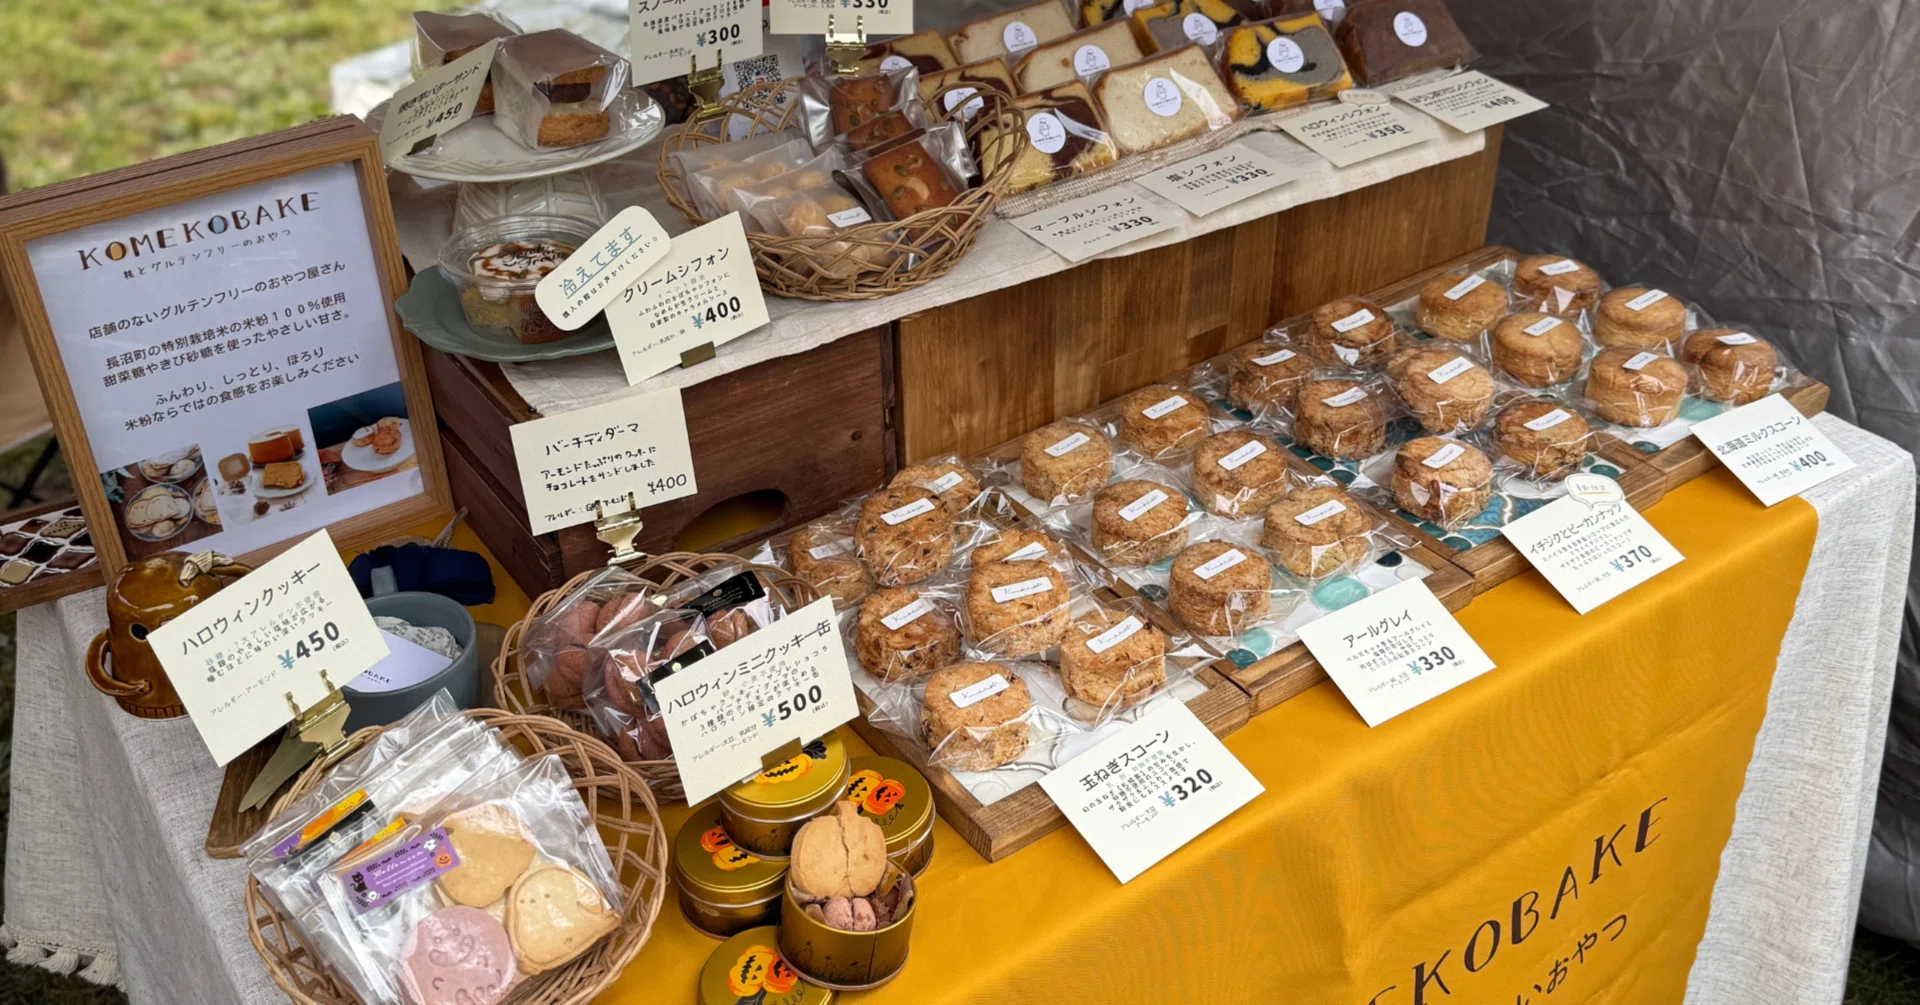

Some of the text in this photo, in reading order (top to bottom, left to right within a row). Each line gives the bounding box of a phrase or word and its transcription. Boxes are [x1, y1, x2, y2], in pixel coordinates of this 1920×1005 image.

[639, 0, 686, 13] スノー
[840, 0, 888, 9] ¥330
[696, 24, 740, 47] ¥300
[426, 102, 463, 128] ¥450
[1300, 105, 1380, 132] ハロウィンシフォン
[1482, 95, 1517, 110] ¥400
[1366, 124, 1406, 140] ¥350
[1165, 155, 1236, 182] 塩シフォン
[1226, 168, 1268, 185] ¥330
[78, 192, 320, 270] KOMEKOBAKE
[1107, 215, 1153, 233] ¥330
[559, 226, 634, 296] 冷えてます
[562, 236, 658, 319] 購入の際はお声かけください。
[623, 247, 730, 303] クリームシフォン
[88, 261, 346, 340] 店舗のないグルテンフリーのおやつ屋さん
[638, 272, 730, 317] ふわふわのかぼちゃシフォンに
[654, 285, 719, 318] なめらか生クリームと
[658, 274, 706, 298] イベント限定
[650, 289, 728, 329] 自家製のキャラメルソース
[691, 296, 741, 329] ¥400
[103, 309, 351, 388] 甜菜糖やきび砂糖を使ったやさしい甘さ。
[125, 355, 360, 431] 米粉ならではの食感をお楽しみください
[155, 347, 325, 405] ふんわり、しっとり、ほろり
[545, 422, 640, 456] バーチディダーマ
[1716, 415, 1802, 454] 北海道ミルクスコーン
[545, 458, 656, 492] チョコレートをサンドしました
[1790, 451, 1826, 471] ¥400
[646, 473, 688, 495] ¥400
[1611, 545, 1650, 572] ¥370
[180, 559, 321, 654] ハロウィンクッキー
[207, 599, 333, 683] 噛むほどに味わい深いクッキー
[208, 596, 325, 673] 塩麹のやさしい塩味が広がる
[279, 622, 338, 669] ¥450
[333, 638, 349, 651] (税込)
[1344, 610, 1413, 646] アールグレイ
[1345, 620, 1432, 662] ベルガモット香るアールグレイと
[667, 620, 830, 712] ハロウィンミニクッキー缶
[1408, 647, 1454, 674] ¥330
[700, 671, 818, 737] ハロウィン限定のクッキー缶
[763, 686, 820, 726] ¥500
[812, 701, 828, 713] (税込)
[730, 732, 757, 749] アーモンド
[1080, 728, 1171, 790] 玉ねぎスコーン
[1119, 766, 1187, 812] 朝食にもおススメです
[1160, 769, 1212, 807] ¥320
